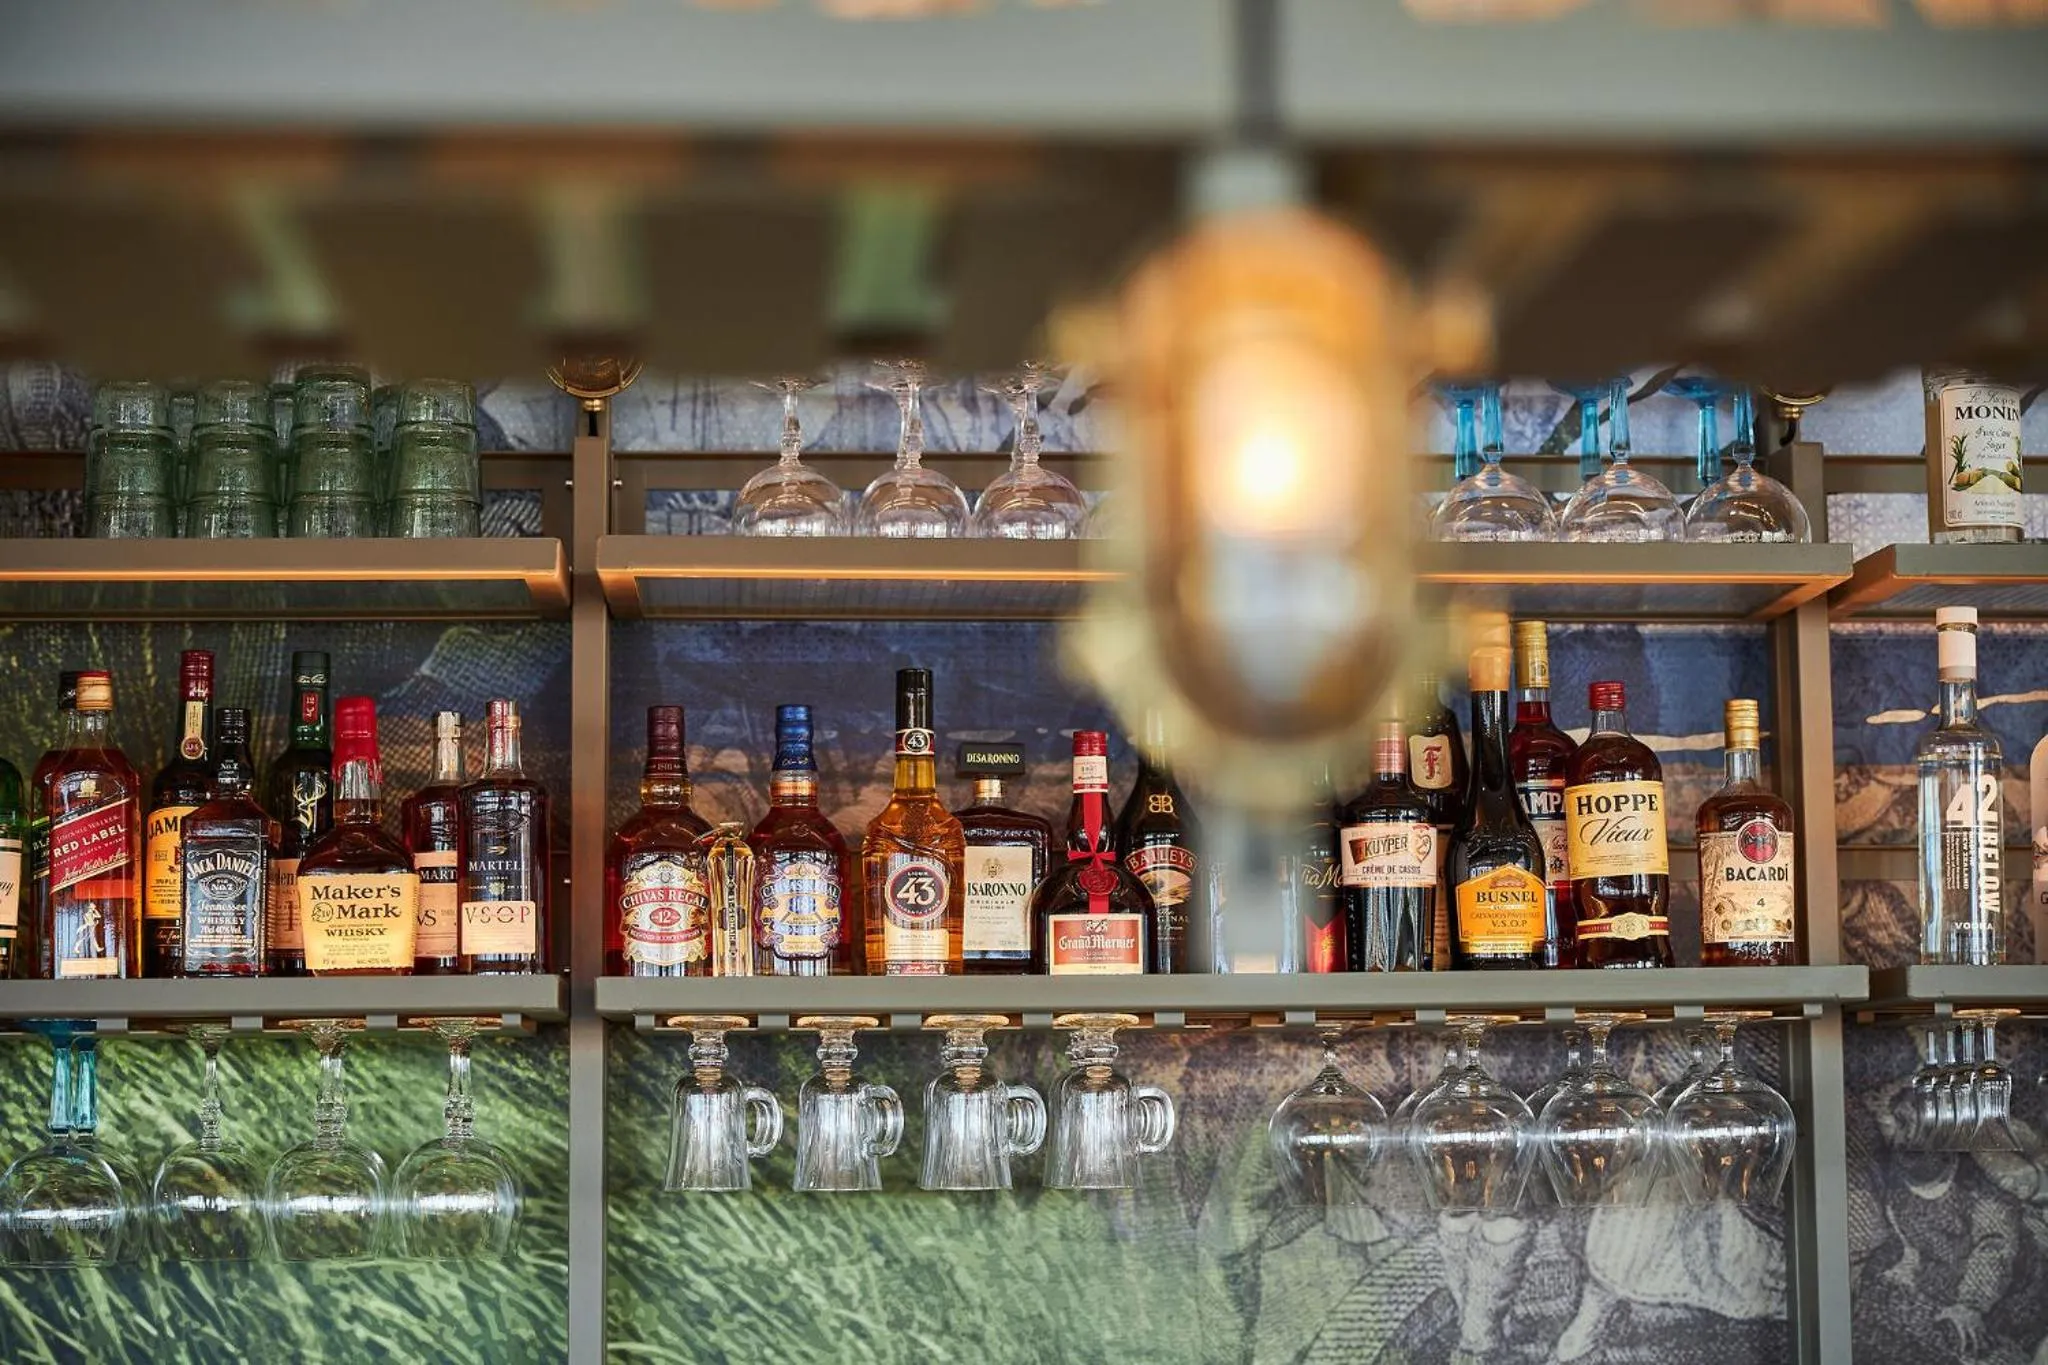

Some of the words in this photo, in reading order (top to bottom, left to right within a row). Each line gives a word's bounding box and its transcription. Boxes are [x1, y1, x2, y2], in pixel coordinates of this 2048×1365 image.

[1955, 405, 2019, 421] MONIN
[907, 734, 925, 748] 43
[966, 752, 1020, 765] DISARONNO
[1576, 794, 1658, 816] HOPPE
[1579, 816, 1655, 846] Vieux
[53, 841, 80, 858] RED
[82, 823, 127, 846] LABEL
[1364, 836, 1408, 857] KUYPER
[1129, 849, 1194, 868] BAILEYS
[186, 855, 216, 880] JACK
[311, 884, 401, 900] Maker's
[896, 877, 936, 905] 43
[966, 882, 1027, 896] ISARONNO
[1476, 891, 1538, 903] BUSNEL
[198, 900, 247, 911] Tennessee
[622, 889, 667, 909] CHIVAS
[668, 889, 708, 909] REGAL
[1756, 898, 1765, 907] 4
[336, 903, 402, 919] Mark
[658, 910, 672, 923] 12
[198, 917, 246, 925] WHISKEY
[324, 927, 389, 937] WHISKY
[1059, 935, 1091, 951] Grand
[1090, 934, 1136, 949] Marnier
